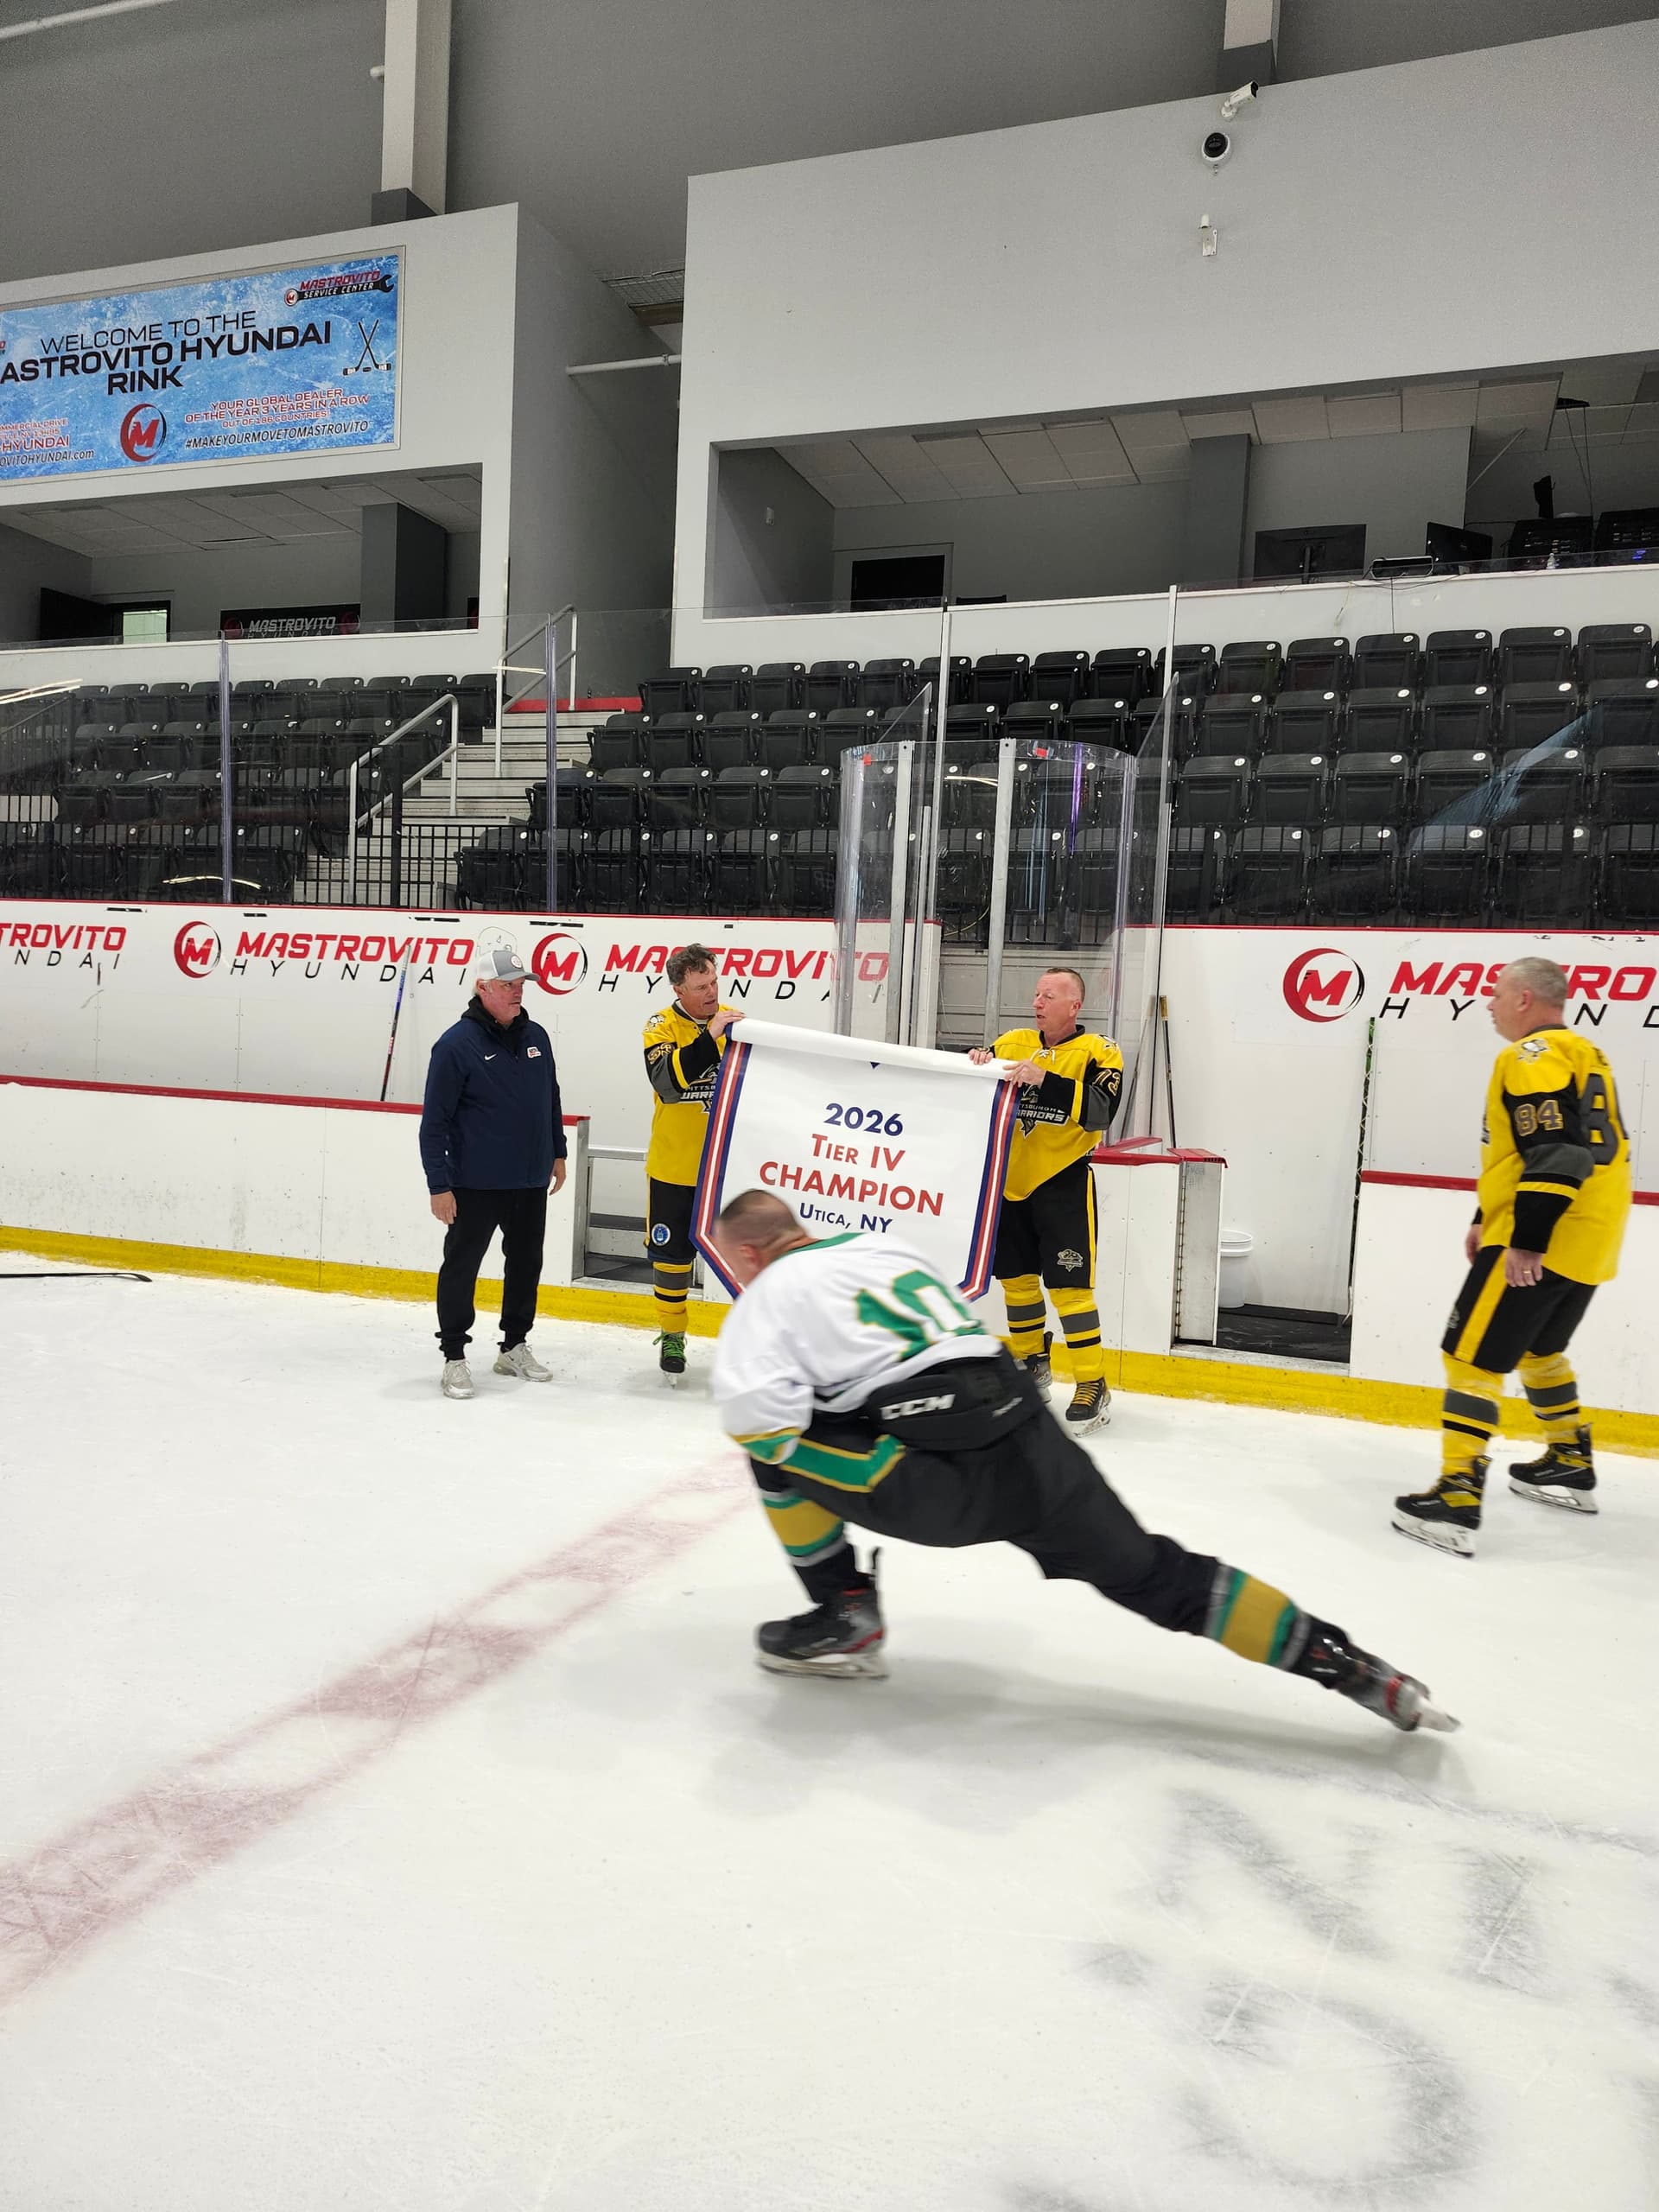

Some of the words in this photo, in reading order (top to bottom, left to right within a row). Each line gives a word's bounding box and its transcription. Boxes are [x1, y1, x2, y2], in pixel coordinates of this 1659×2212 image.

[300, 270, 380, 290] MASTROVITO
[304, 288, 338, 299] SERVICE
[341, 283, 374, 294] CENTER
[41, 323, 162, 354] WELCOME
[168, 318, 200, 338] TO
[206, 310, 257, 334] THE
[0, 342, 173, 385] ASTROVITO
[180, 321, 331, 362] HYUNDAI
[107, 365, 183, 395] RINK
[185, 414, 201, 423] OF
[203, 410, 226, 421] THE
[228, 407, 259, 417] YEAR
[273, 401, 312, 412] YEARS
[315, 399, 327, 409] IN
[340, 395, 370, 405] ROW
[212, 400, 244, 410] YOUR
[246, 394, 294, 407] GLOBAL
[295, 389, 343, 402] DEALER
[43, 418, 67, 428] DRIVE
[185, 420, 369, 448] #MAKEYOURMOVETOMASTROVITO
[2, 435, 70, 452] HYUNDAI
[249, 616, 336, 633] MASTROVITO
[235, 931, 474, 967] MASTROVITO
[230, 957, 466, 985] HYUNDAI
[823, 1103, 904, 1137] 2026
[1514, 1099, 1564, 1137] 84
[870, 1145, 906, 1172] IV
[760, 1160, 944, 1217] CHAMPION
[860, 1213, 893, 1234] NY
[879, 1393, 957, 1421] CCM
